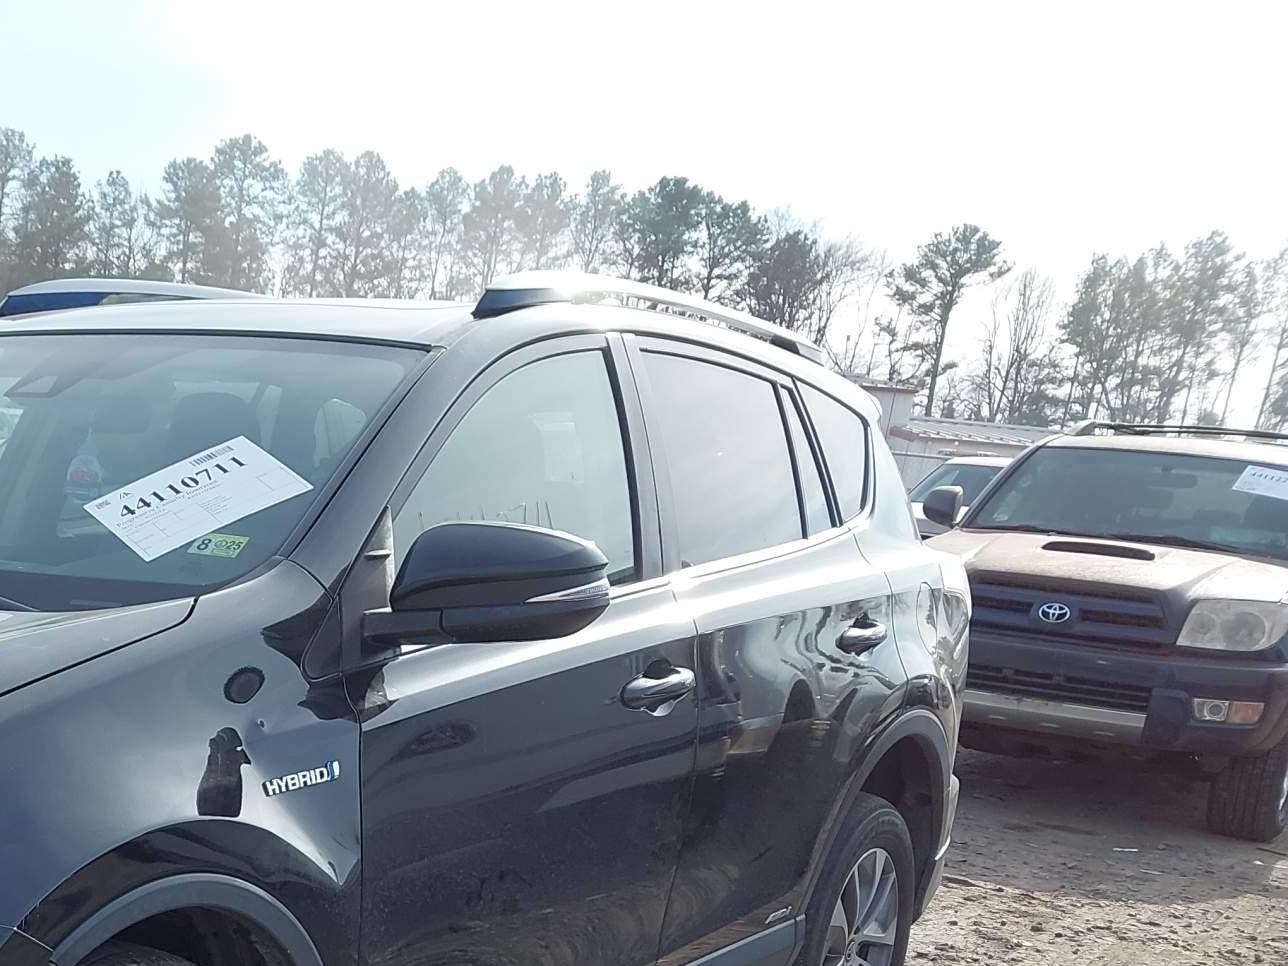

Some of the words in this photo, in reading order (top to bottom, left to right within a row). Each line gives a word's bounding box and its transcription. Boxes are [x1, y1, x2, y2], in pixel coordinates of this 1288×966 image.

[120, 456, 247, 518] 44110711
[197, 538, 212, 550] 8
[265, 766, 329, 796] HYBRID
